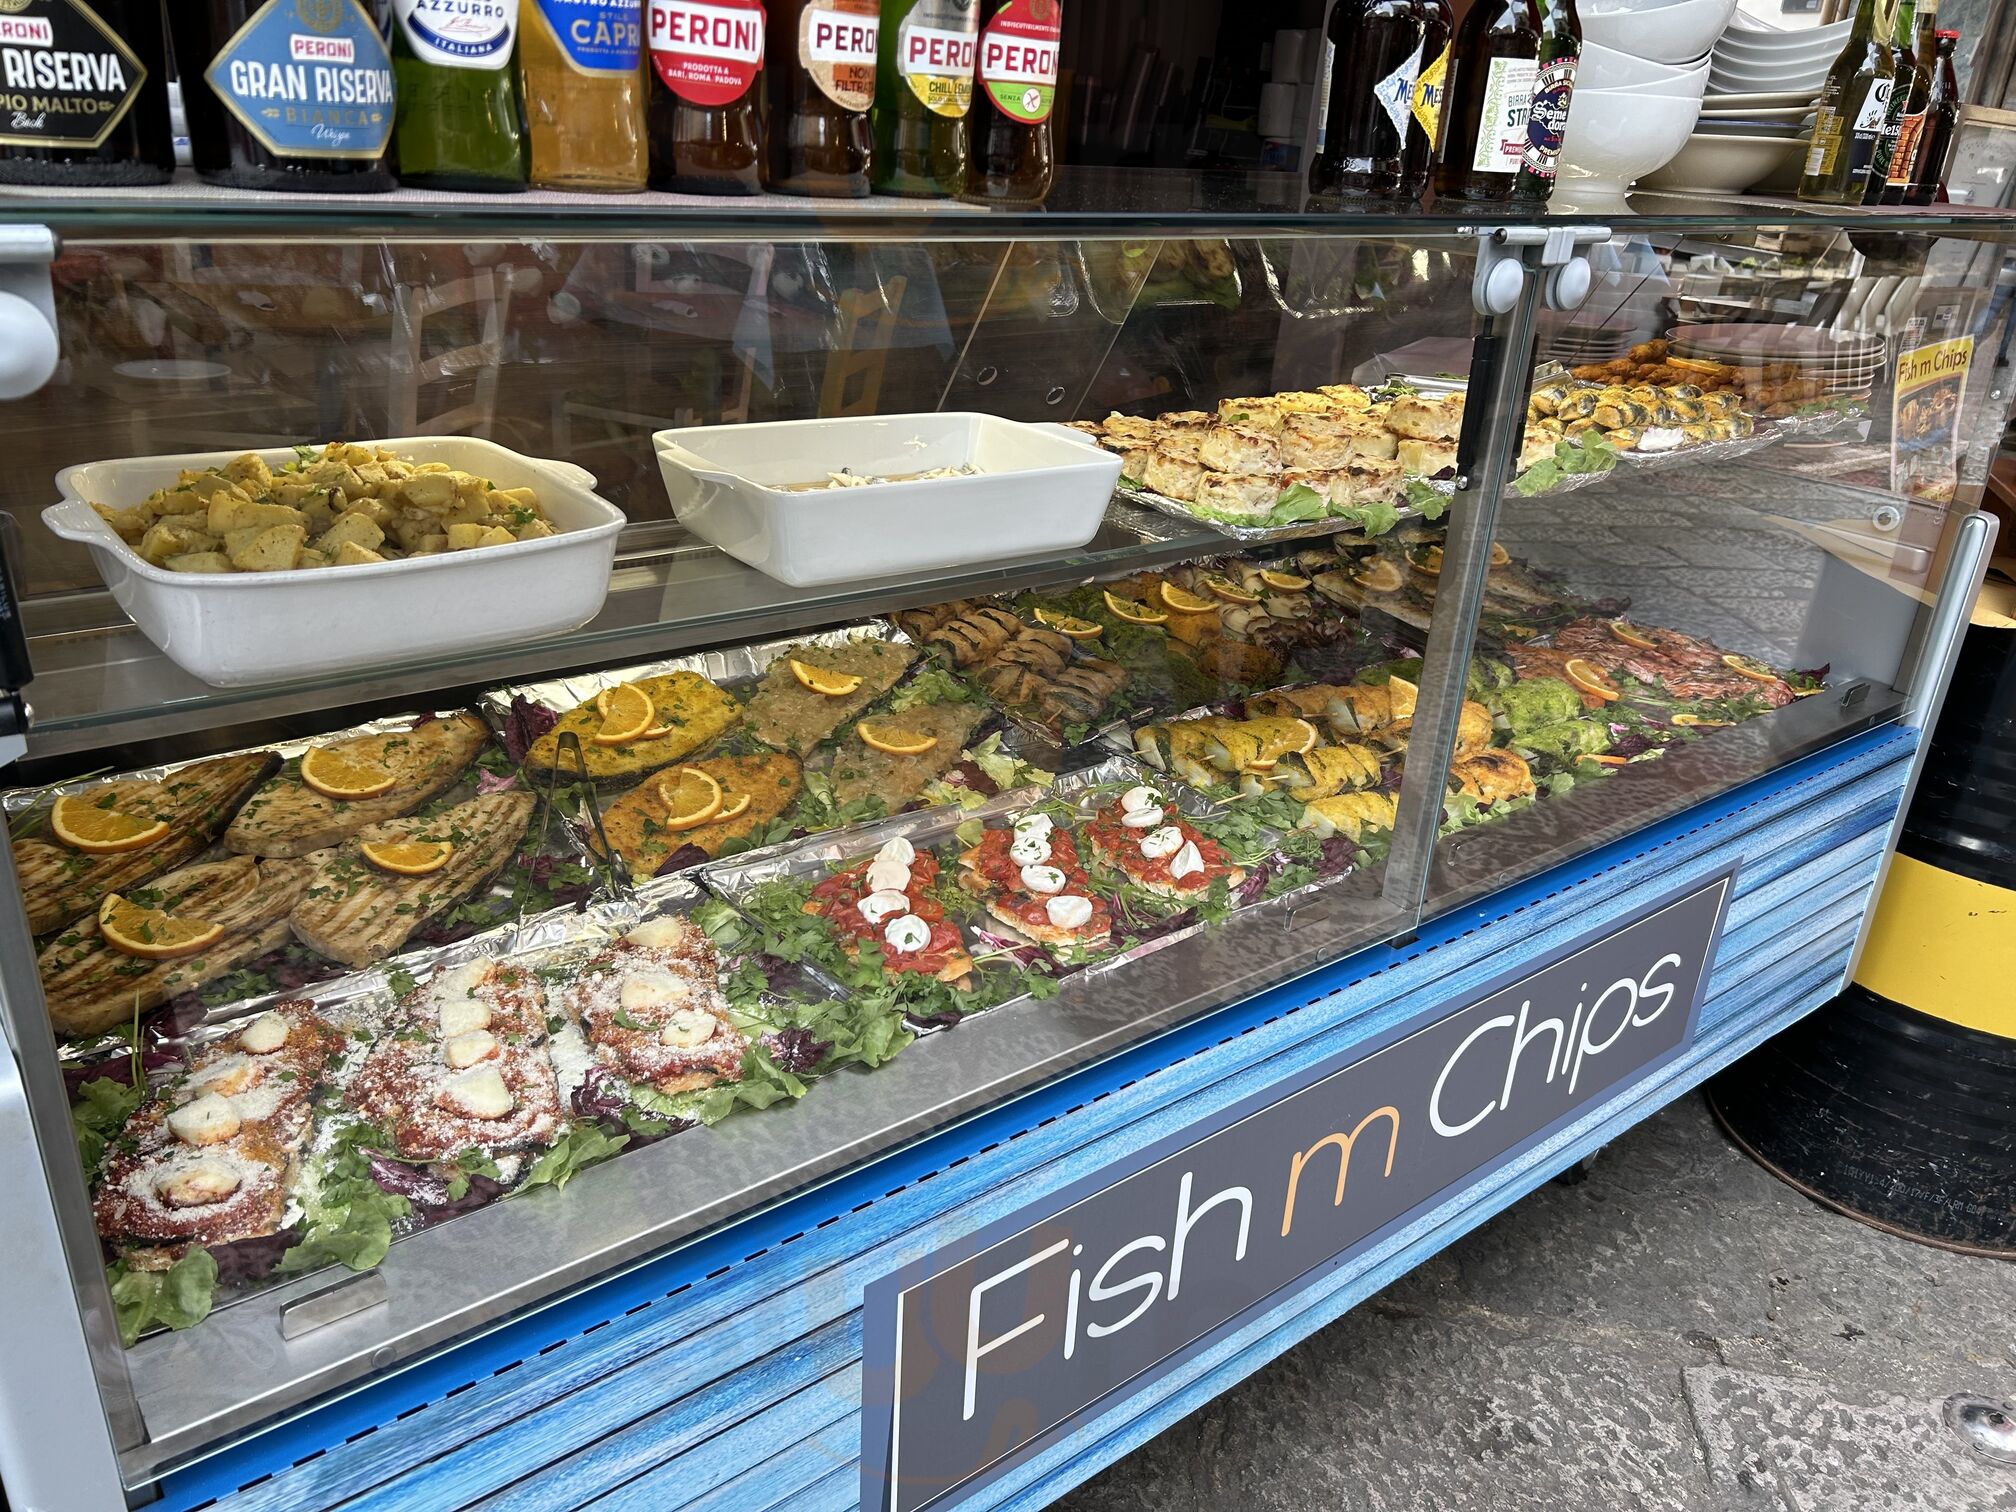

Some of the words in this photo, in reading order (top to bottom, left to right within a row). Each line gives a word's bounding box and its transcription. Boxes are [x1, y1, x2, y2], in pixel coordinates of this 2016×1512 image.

[417, 0, 504, 18] AZZURRO
[0, 21, 49, 40] RONI
[651, 7, 757, 52] PERONI
[293, 39, 352, 58] PERONI
[435, 37, 493, 55] ITALIANA
[2, 47, 127, 92] RISERVA
[682, 61, 723, 75] PRODOTTA
[723, 66, 730, 75] A
[230, 60, 308, 101] GRAN
[314, 66, 393, 104] RISERVA
[714, 75, 743, 86] PADOVA
[929, 81, 952, 93] CHILL
[32, 95, 98, 114] MALTO
[1000, 94, 1021, 102] SENZA
[286, 106, 369, 127] BIANCA
[1898, 357, 1917, 384] Fish
[1920, 359, 1931, 376] m
[1933, 348, 1968, 371] Chips
[963, 1171, 1253, 1421] Fish
[1280, 1105, 1401, 1237] m
[1428, 952, 1682, 1139] Chips
